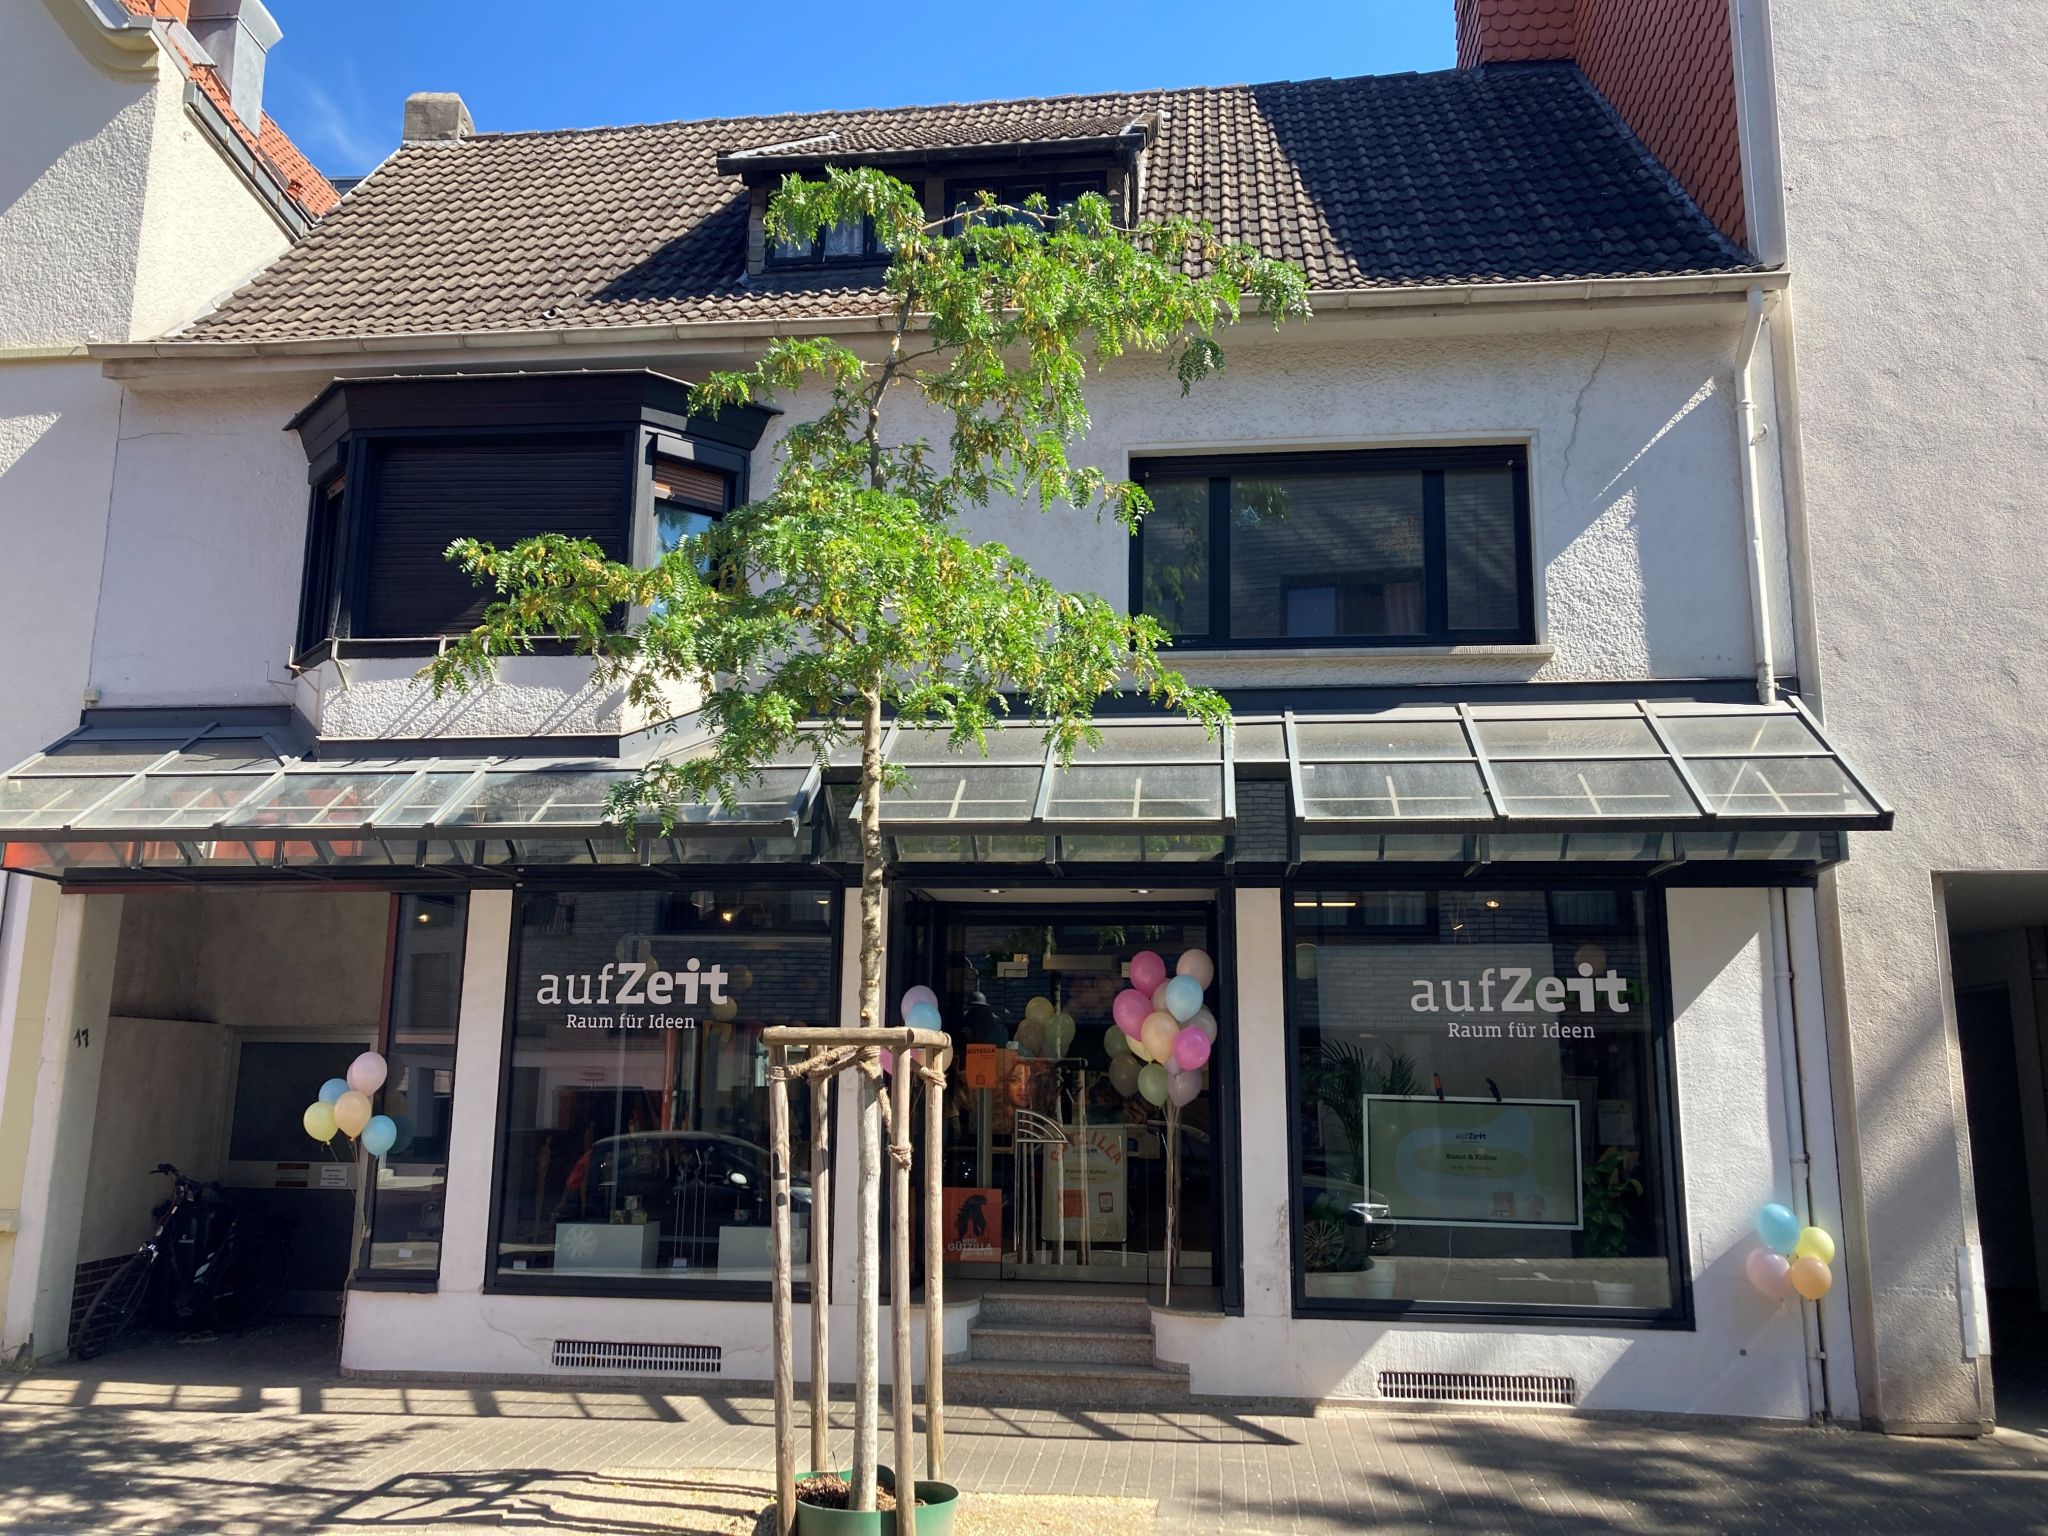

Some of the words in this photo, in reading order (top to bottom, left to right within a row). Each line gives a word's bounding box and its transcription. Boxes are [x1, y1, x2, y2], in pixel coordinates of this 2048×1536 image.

[536, 957, 728, 1005] aufZeit
[1410, 962, 1630, 1013] aufZeit
[566, 1014, 614, 1029] Raum
[618, 1013, 645, 1029] für
[648, 1014, 695, 1029] Ideen
[1447, 1022, 1502, 1038] Raum
[1507, 1022, 1537, 1038] für
[1542, 1022, 1595, 1039] Ideen
[947, 1241, 993, 1252] GÜTZILLA
